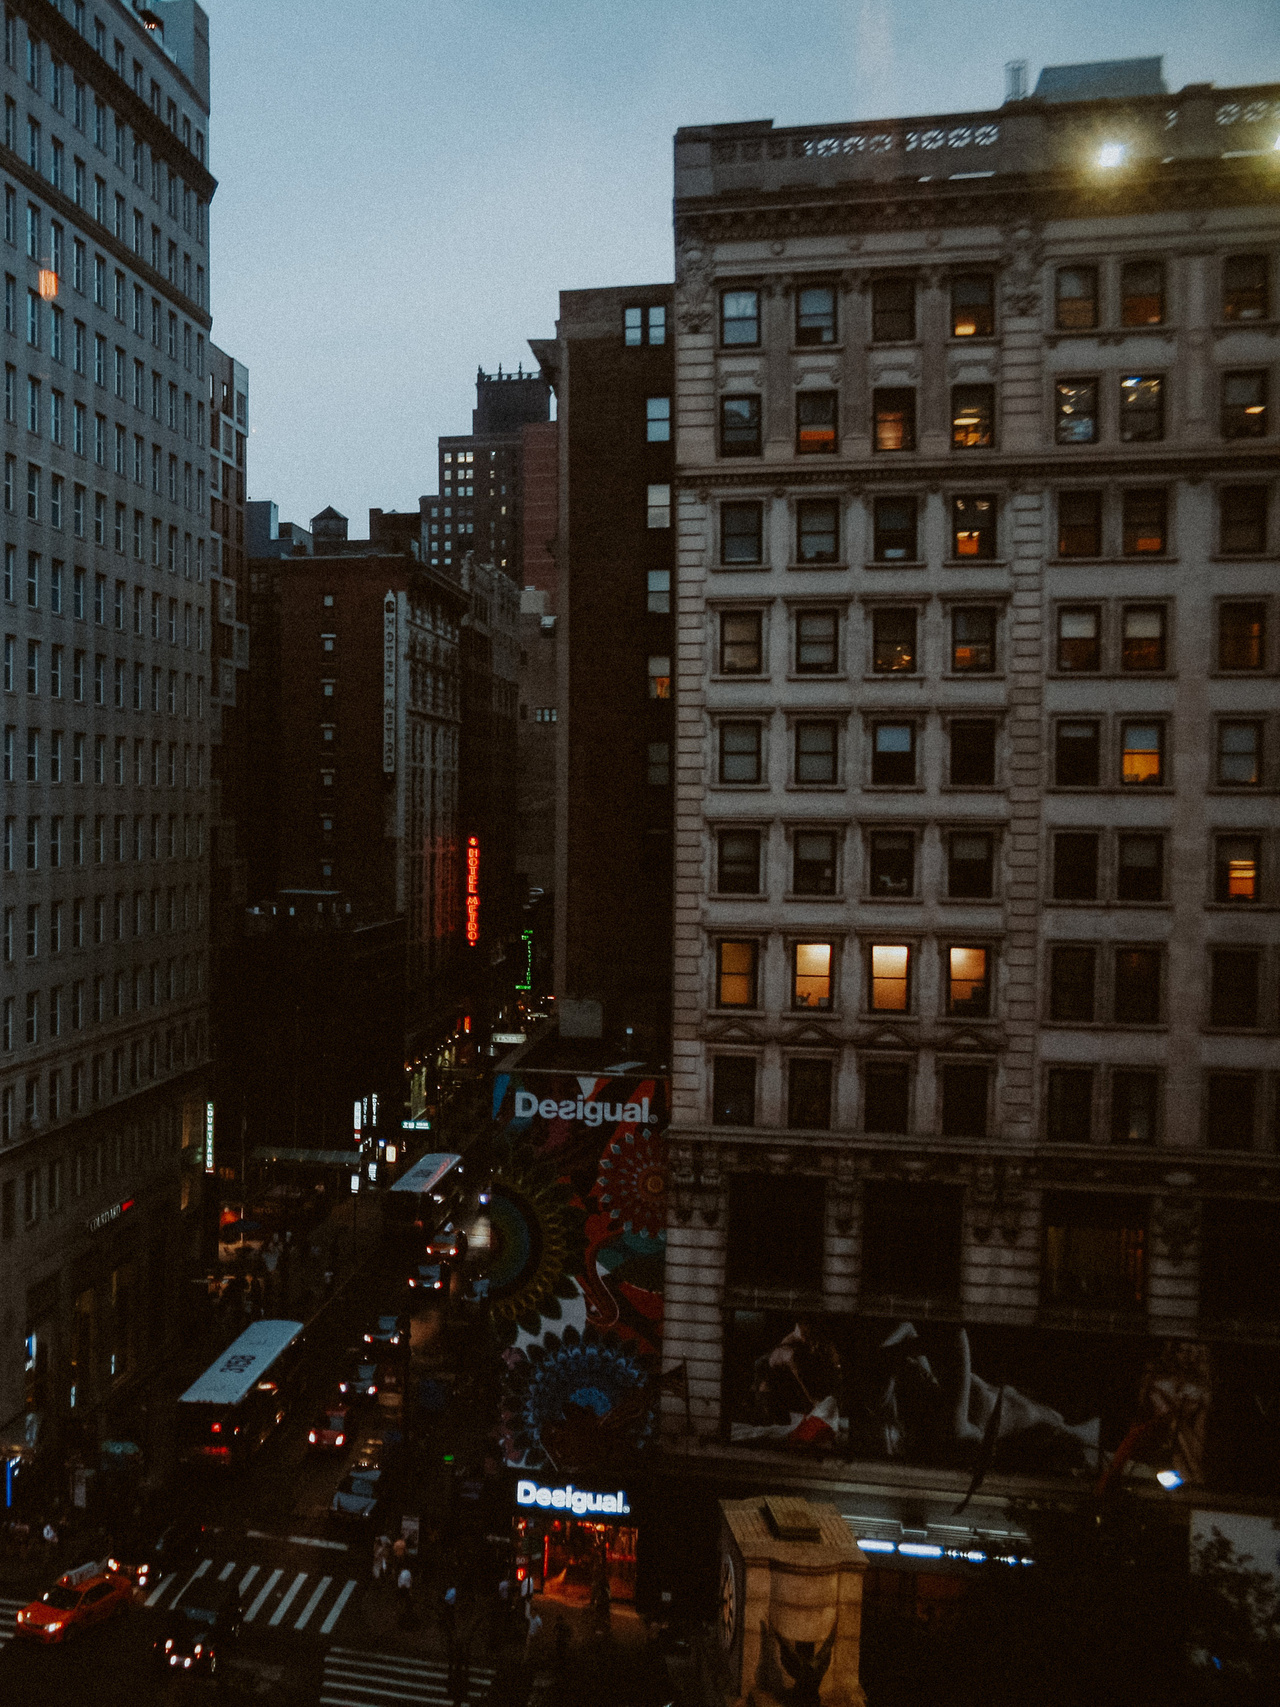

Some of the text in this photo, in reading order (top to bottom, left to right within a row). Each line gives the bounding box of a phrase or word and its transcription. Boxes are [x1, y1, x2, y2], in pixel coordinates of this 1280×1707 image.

[384, 617, 394, 767] HOTEL METRO
[467, 848, 480, 940] HOTEL METRO
[206, 1103, 214, 1168] COURTYARD
[514, 1091, 650, 1127] Desigual
[516, 1480, 625, 1515] Desigual
